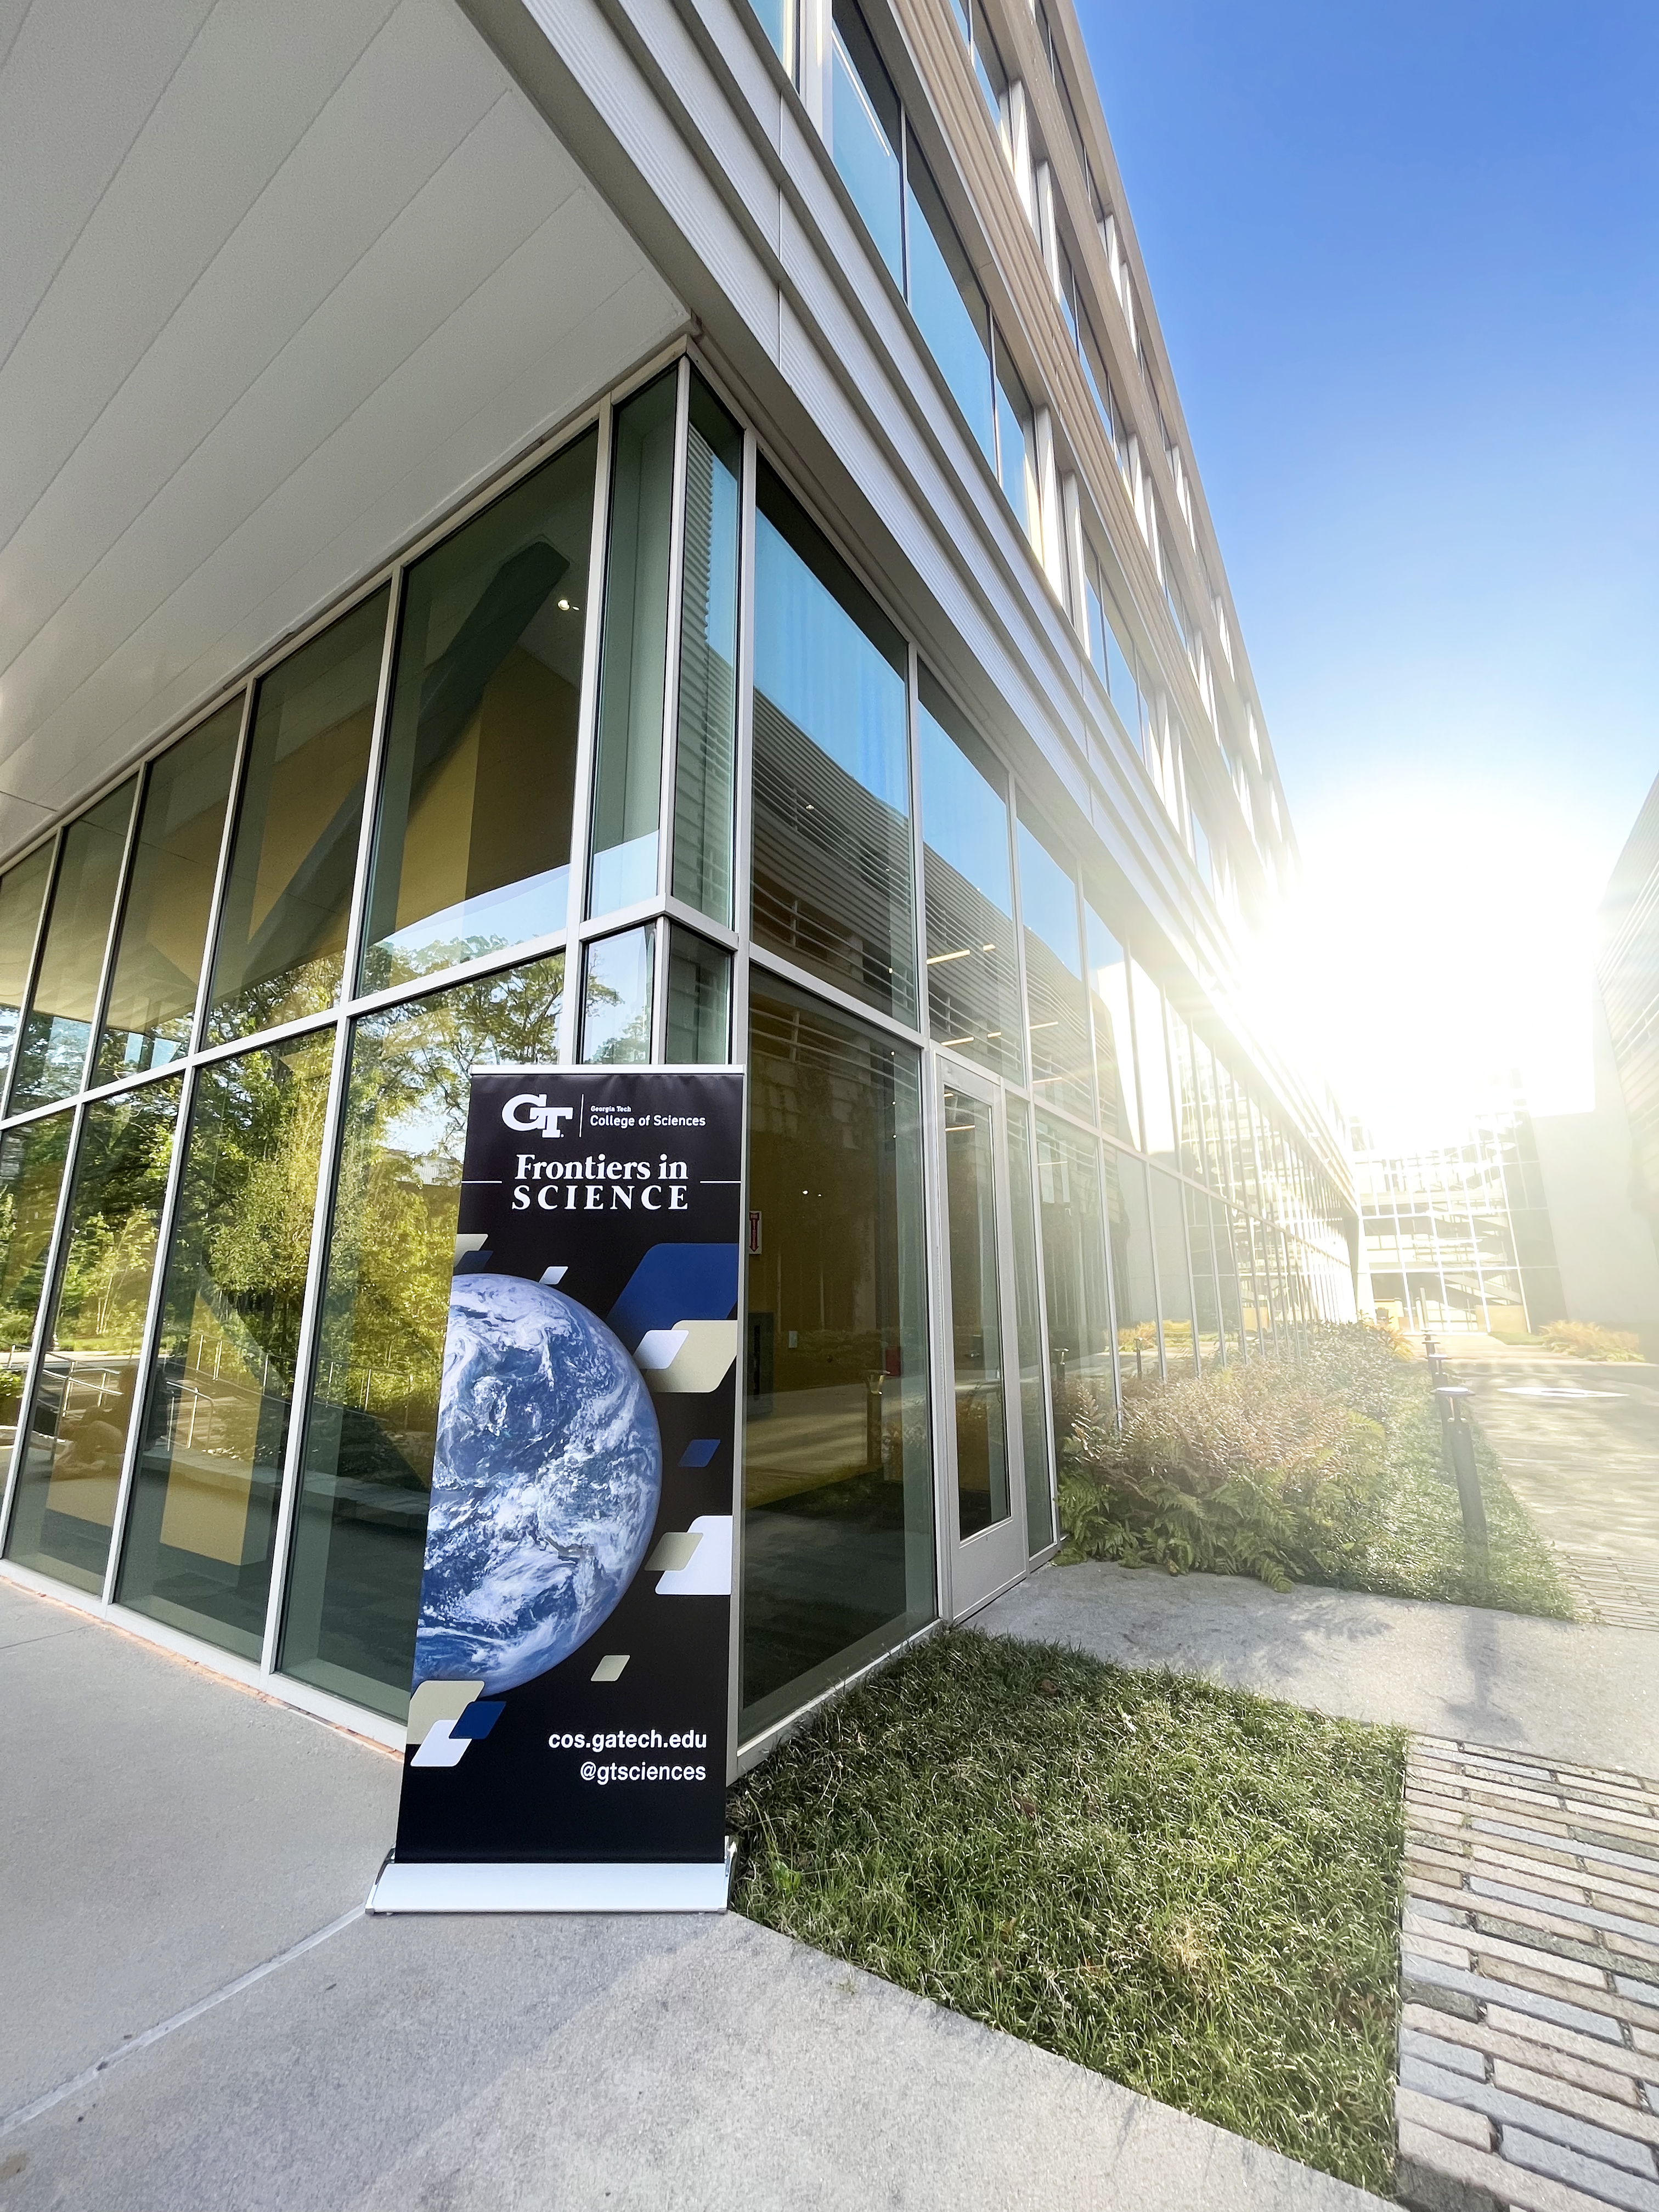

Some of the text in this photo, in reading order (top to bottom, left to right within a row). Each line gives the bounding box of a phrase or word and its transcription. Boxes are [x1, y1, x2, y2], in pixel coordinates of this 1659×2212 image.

[501, 1093, 574, 1138] GT
[590, 1114, 706, 1128] College of Sciences
[515, 1154, 689, 1180] Frontiers in
[511, 1184, 688, 1210] SCIENCE
[548, 1729, 707, 1753] cos.gatech.edu
[580, 1761, 706, 1785] @gtsciences
